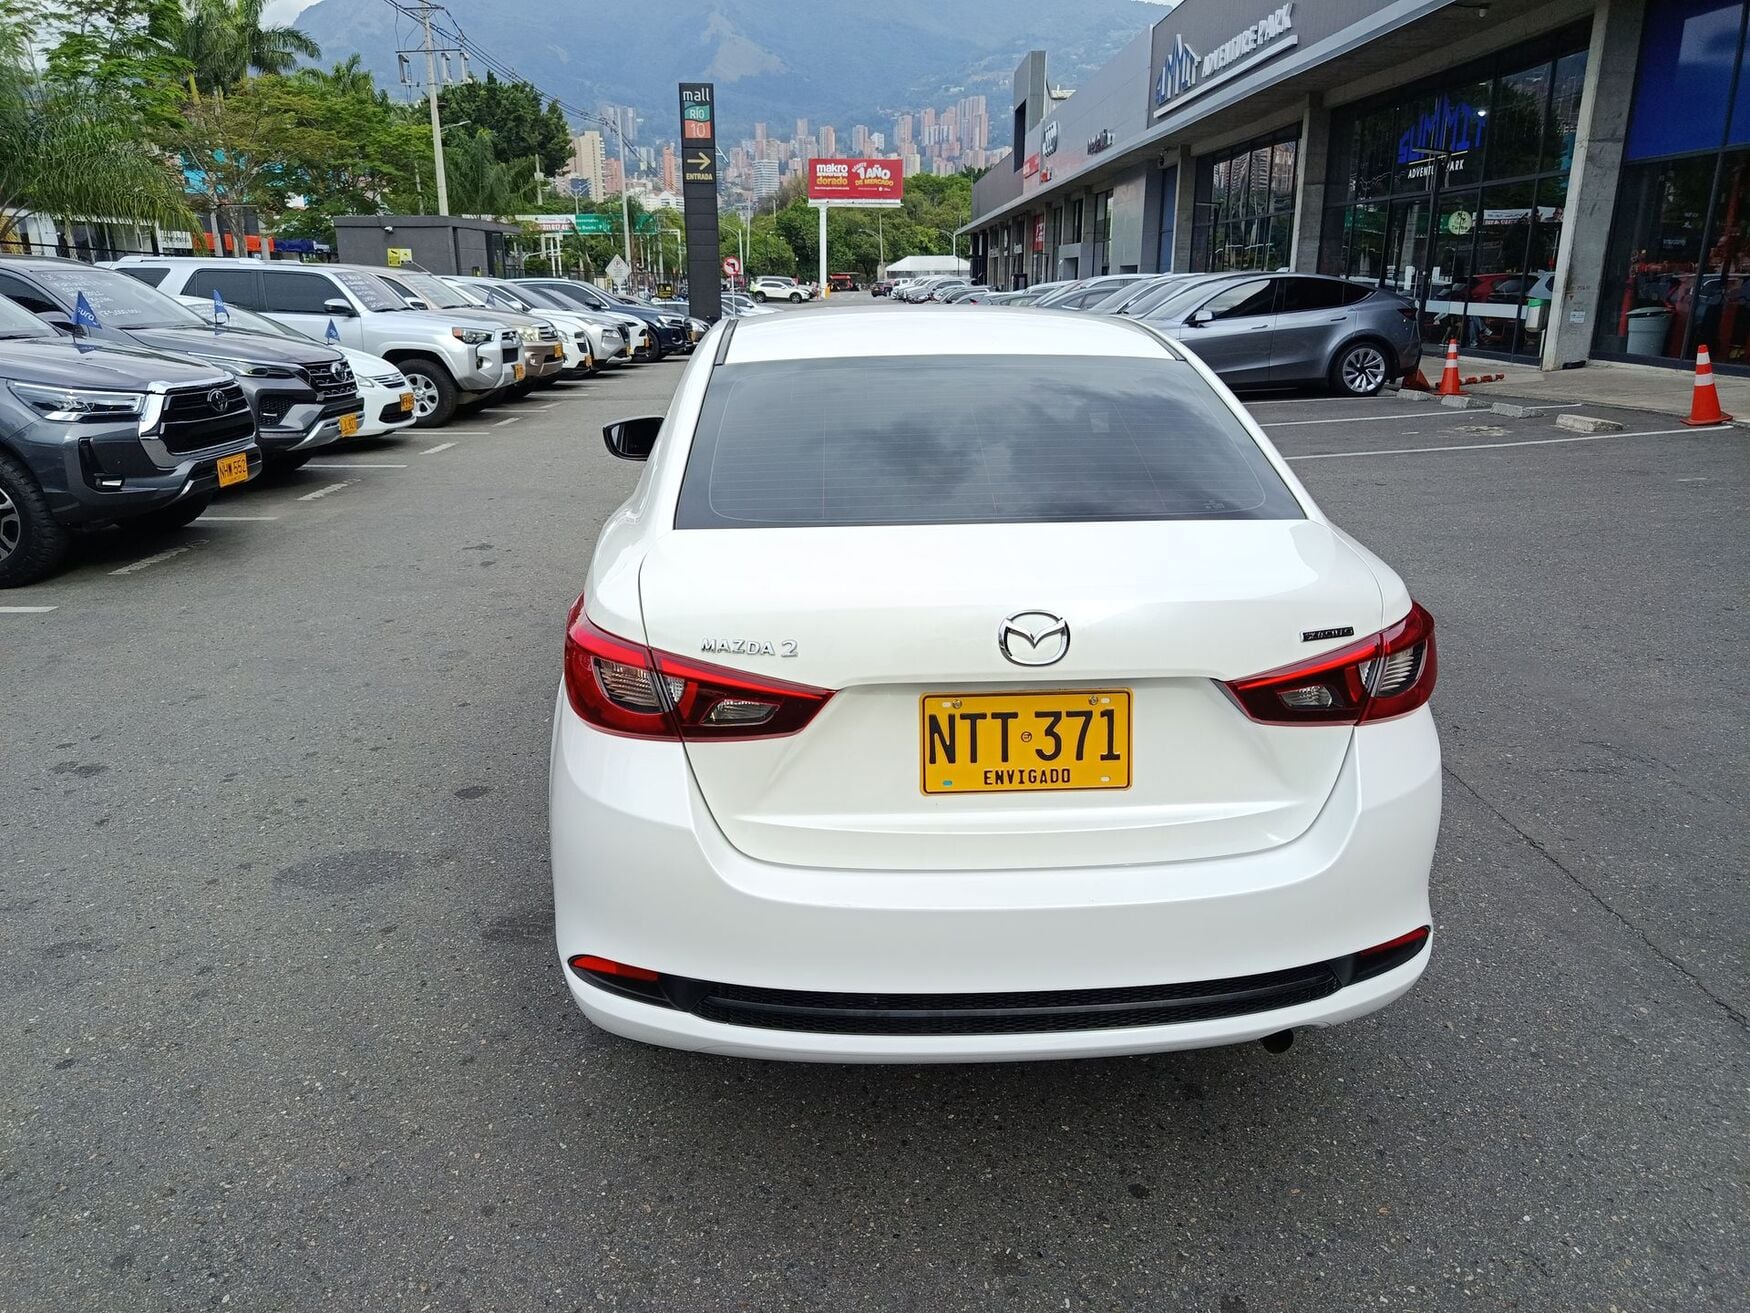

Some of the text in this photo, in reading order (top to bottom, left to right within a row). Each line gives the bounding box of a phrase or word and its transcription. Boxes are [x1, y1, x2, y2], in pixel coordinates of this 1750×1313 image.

[1202, 2, 1294, 78] ADVENTURE PARK
[682, 87, 710, 101] mall
[691, 123, 706, 137] 10
[816, 163, 848, 172] makro
[857, 167, 865, 179] 1
[866, 164, 891, 179] AÑO
[816, 177, 848, 185] dorado
[701, 638, 798, 658] MAZDA 2
[928, 708, 1121, 764] NTT 371
[983, 768, 1071, 785] ENVIGADO
